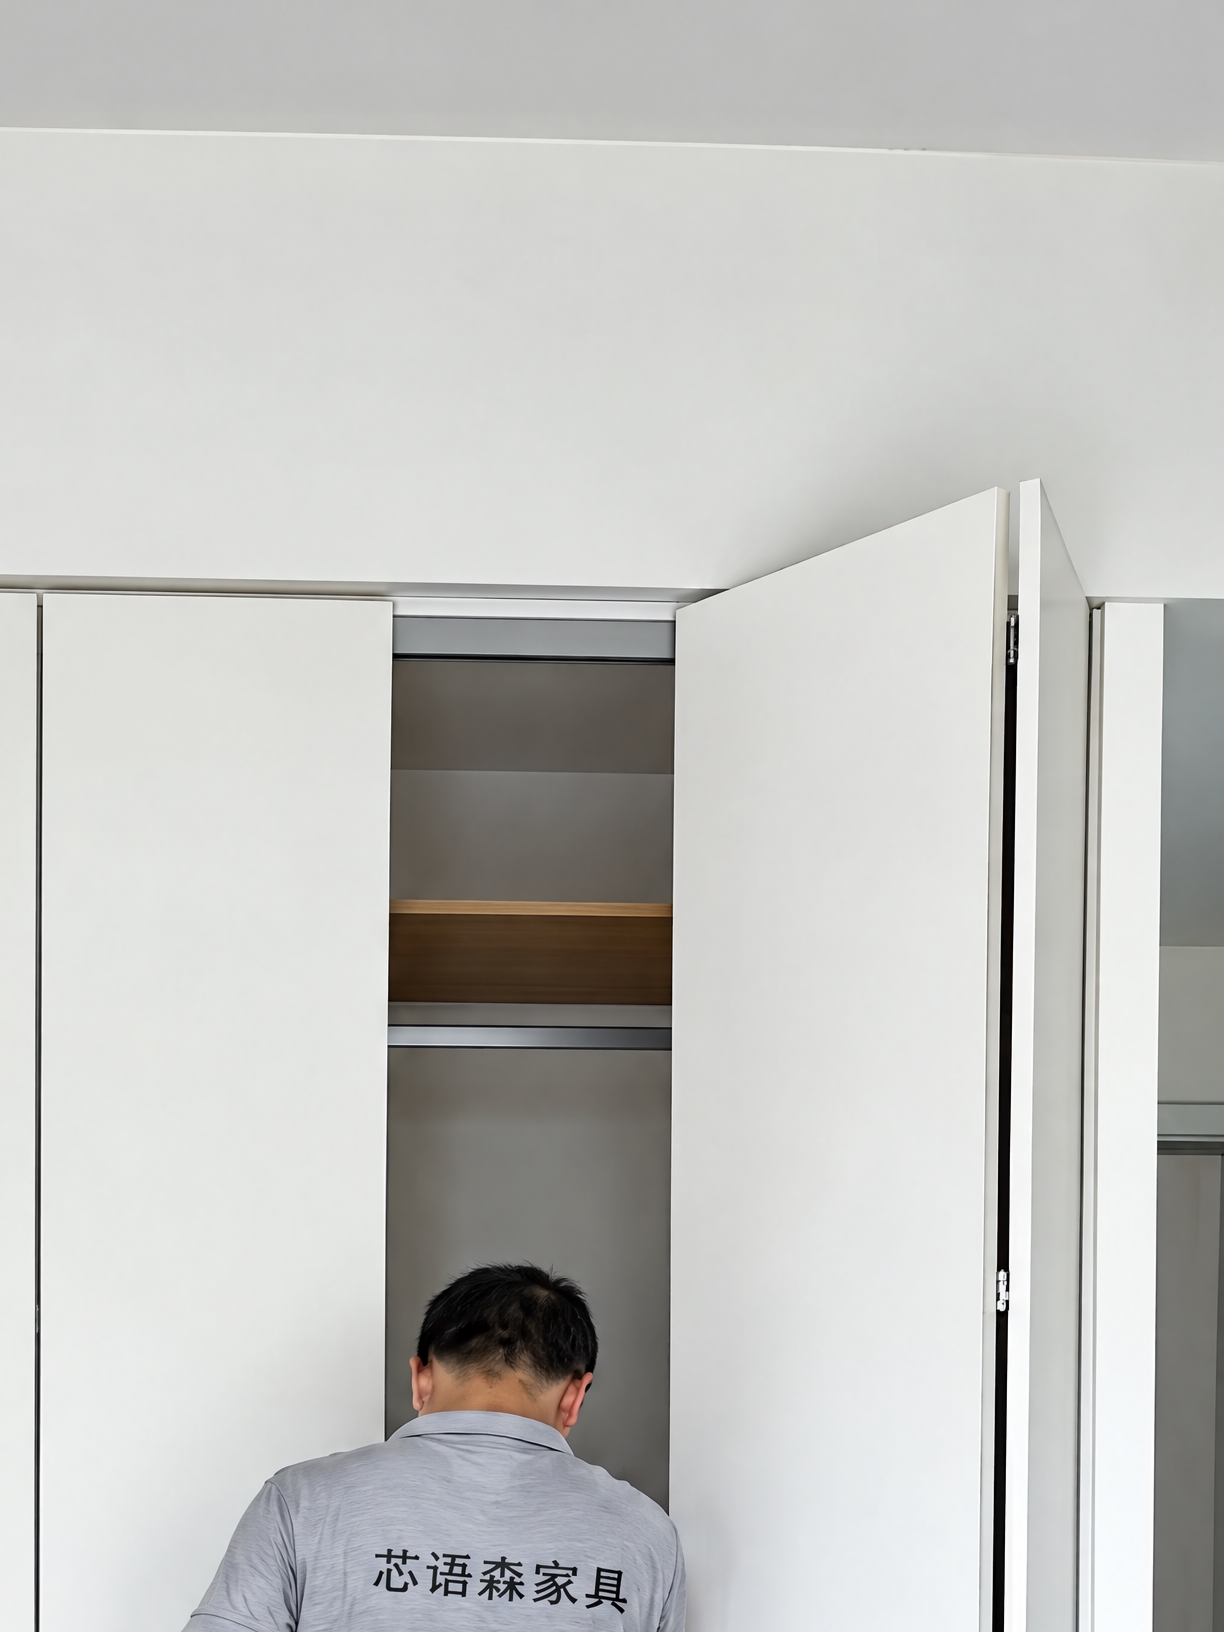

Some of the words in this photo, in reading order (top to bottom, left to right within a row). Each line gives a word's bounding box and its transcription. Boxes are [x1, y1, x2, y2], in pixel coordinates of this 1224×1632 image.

[373, 1549, 628, 1614] 芯语森家具
